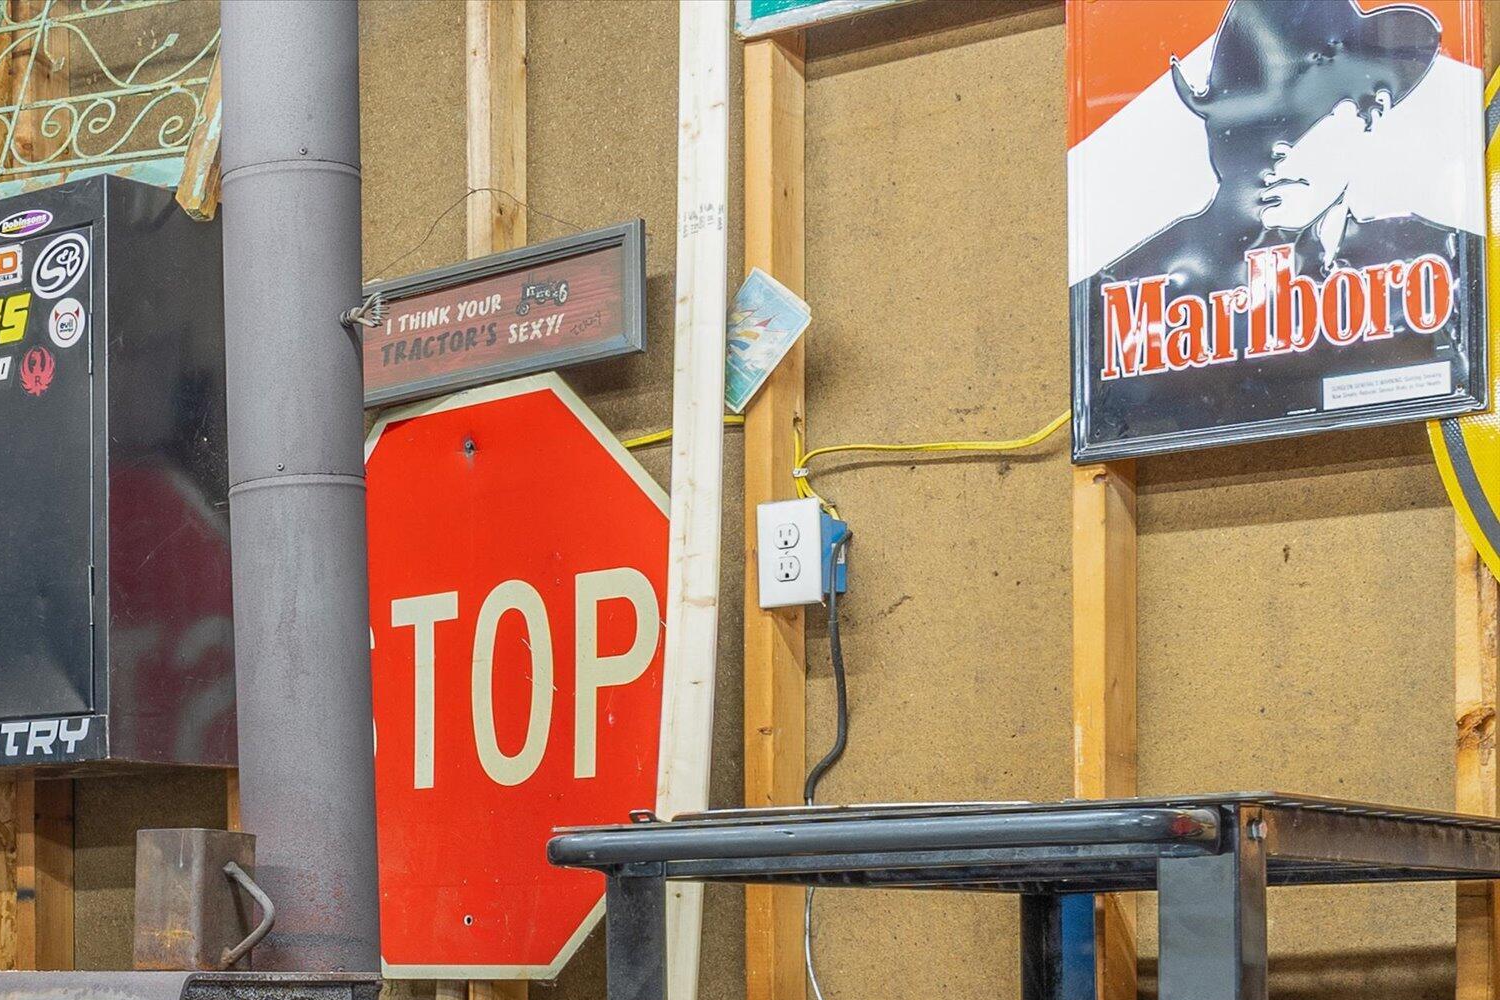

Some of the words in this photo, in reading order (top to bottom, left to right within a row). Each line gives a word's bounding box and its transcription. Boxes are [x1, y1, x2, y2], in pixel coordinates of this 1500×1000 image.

[1, 214, 48, 232] Dobinsons
[386, 318, 393, 336] I
[398, 306, 451, 333] THINK
[456, 293, 502, 322] YOUR
[1100, 241, 1455, 382] Marlboro
[380, 322, 499, 367] TRACTOR'S
[507, 313, 565, 344] SEXY!
[370, 566, 661, 790] TOP
